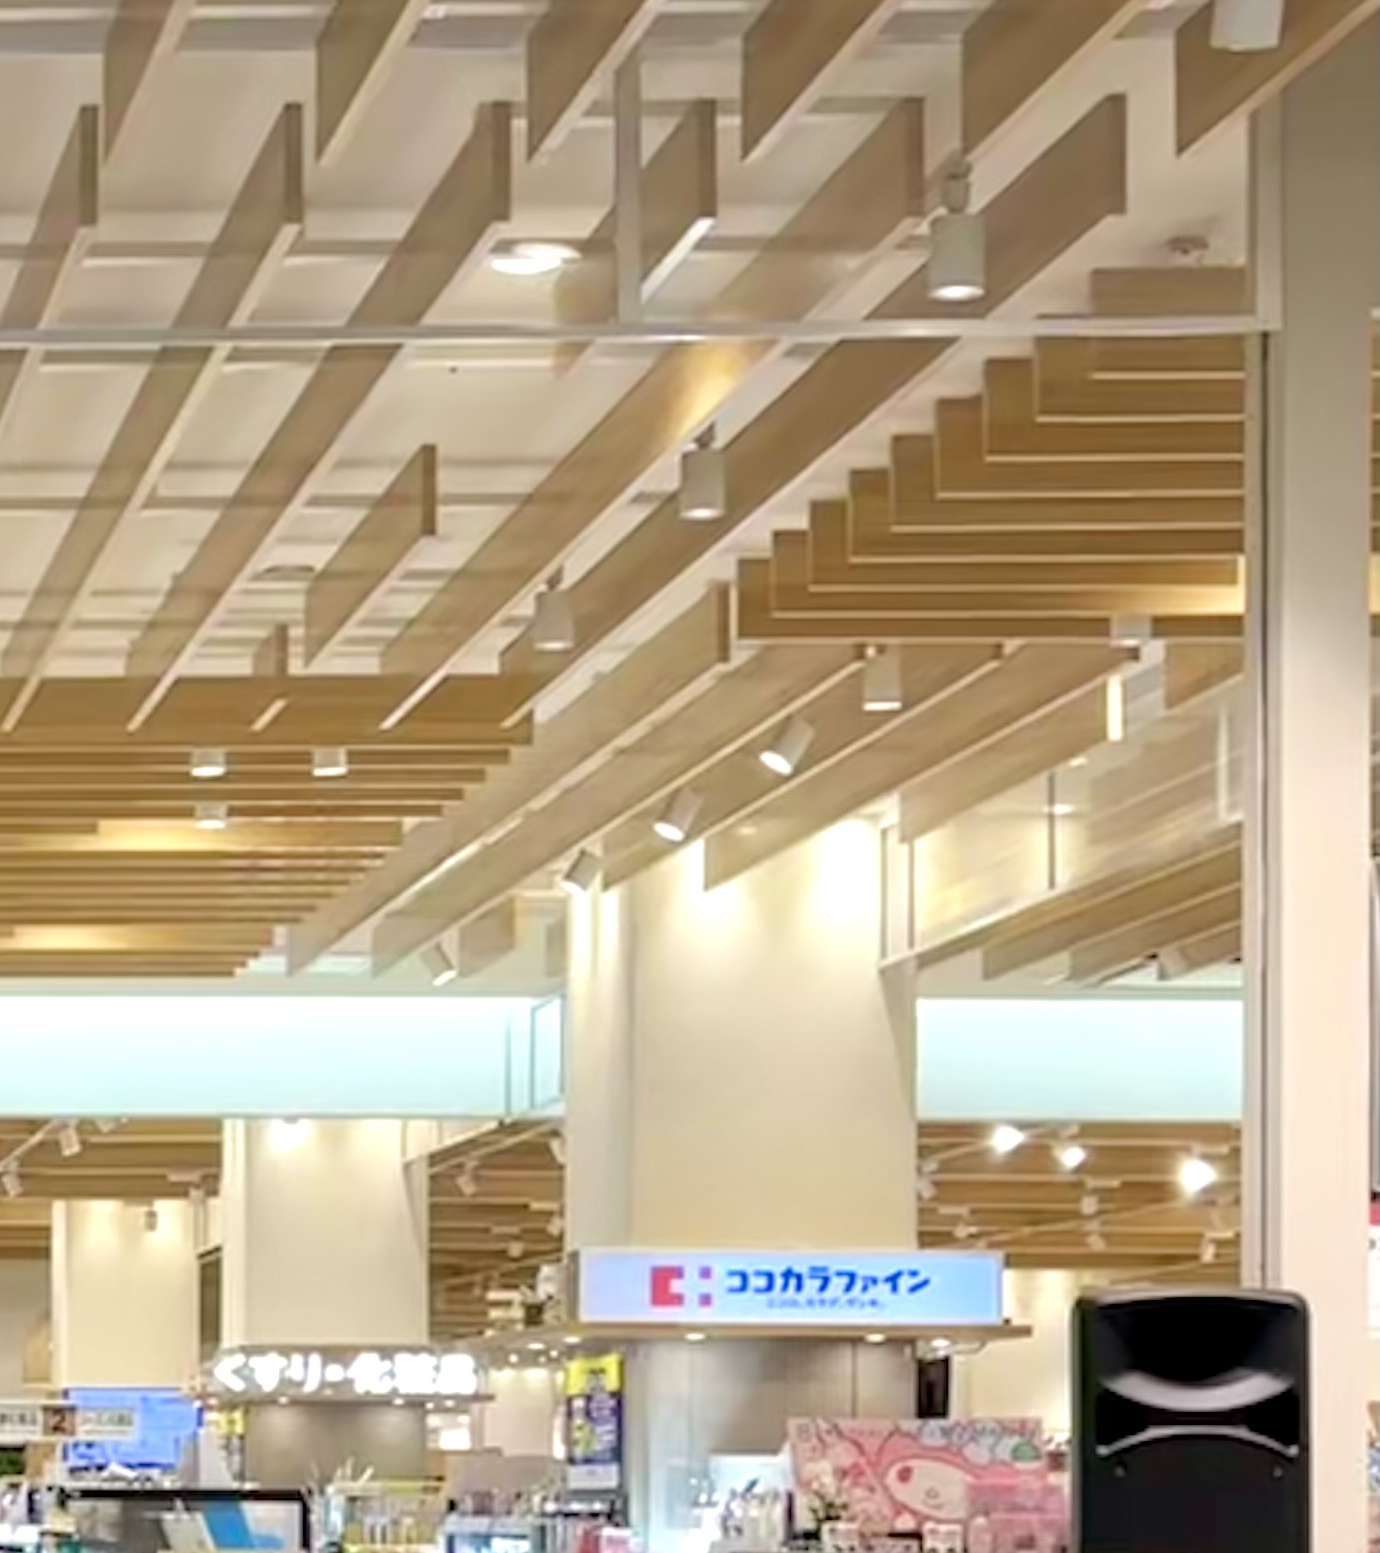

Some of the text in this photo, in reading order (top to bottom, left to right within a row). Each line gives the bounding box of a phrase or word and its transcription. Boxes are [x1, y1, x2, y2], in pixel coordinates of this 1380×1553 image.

[726, 1265, 931, 1294] ココカラファイン
